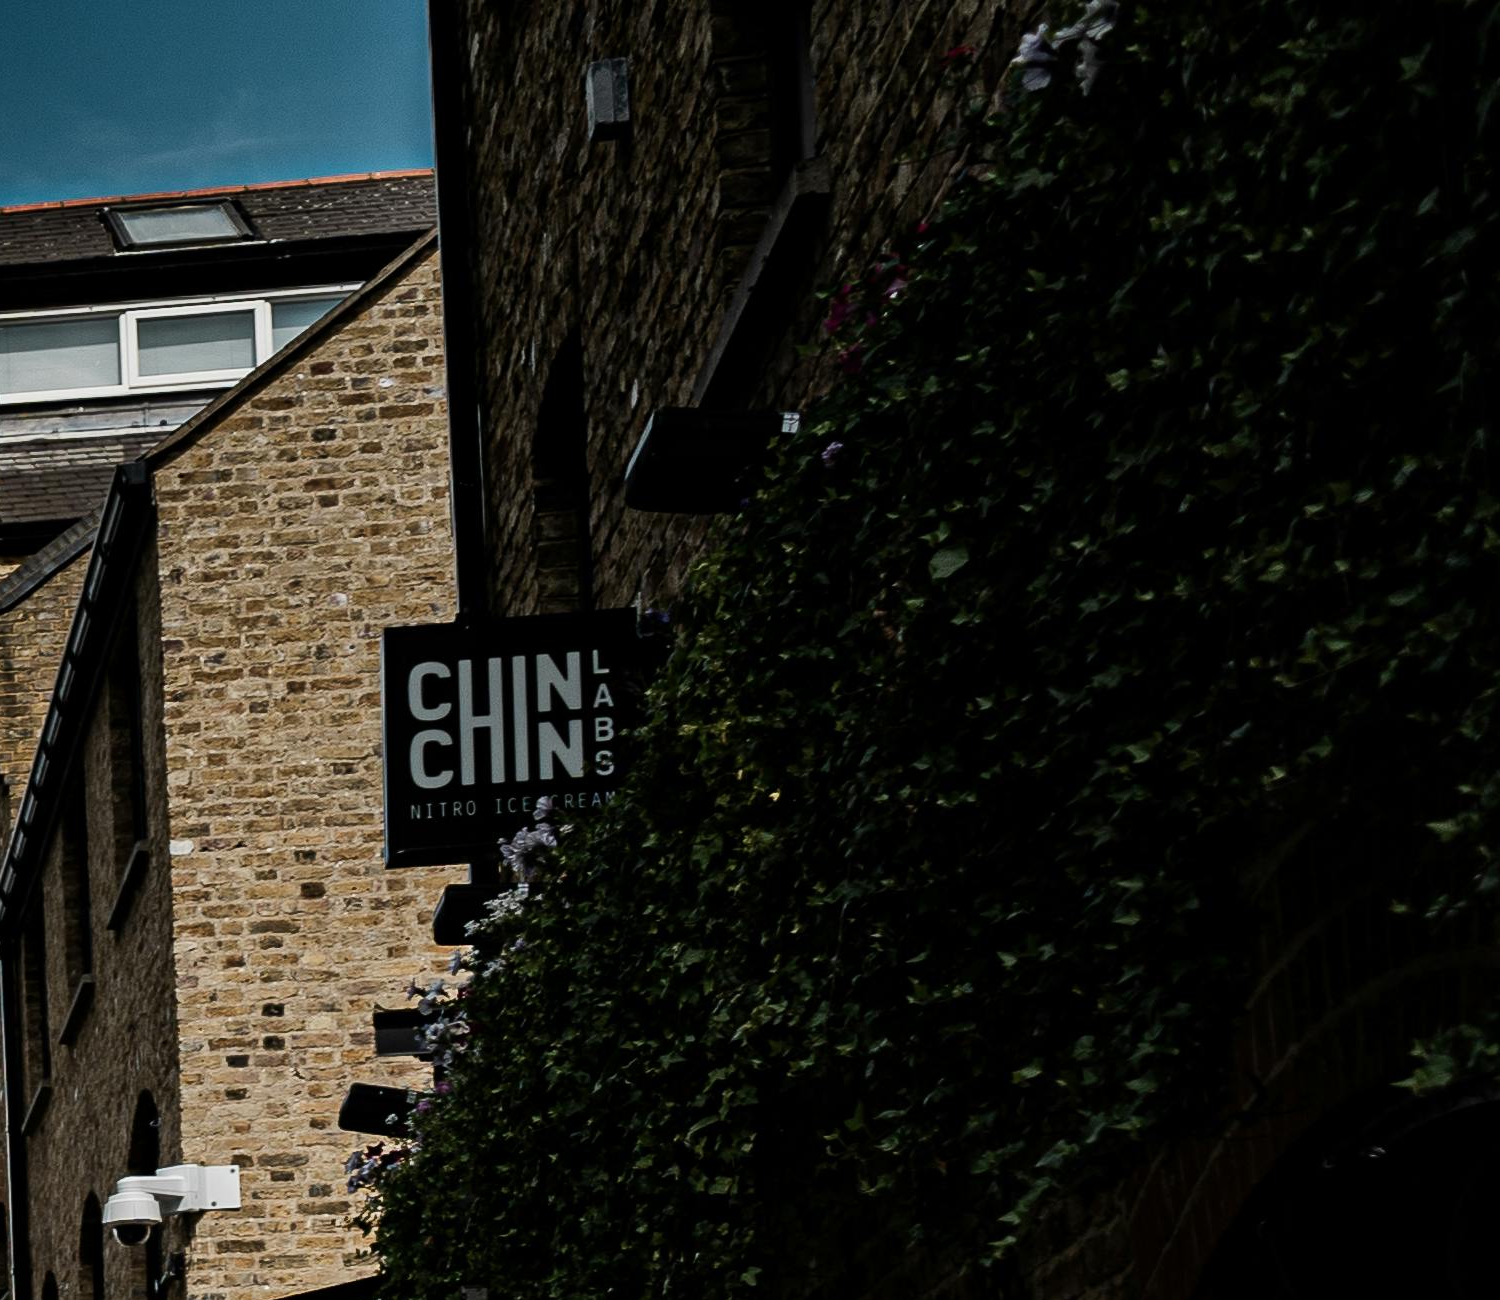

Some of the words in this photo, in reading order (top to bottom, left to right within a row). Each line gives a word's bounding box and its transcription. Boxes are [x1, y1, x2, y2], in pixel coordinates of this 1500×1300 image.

[592, 649, 615, 776] LABS
[411, 800, 477, 820] NITRO
[495, 797, 531, 814] ICE
